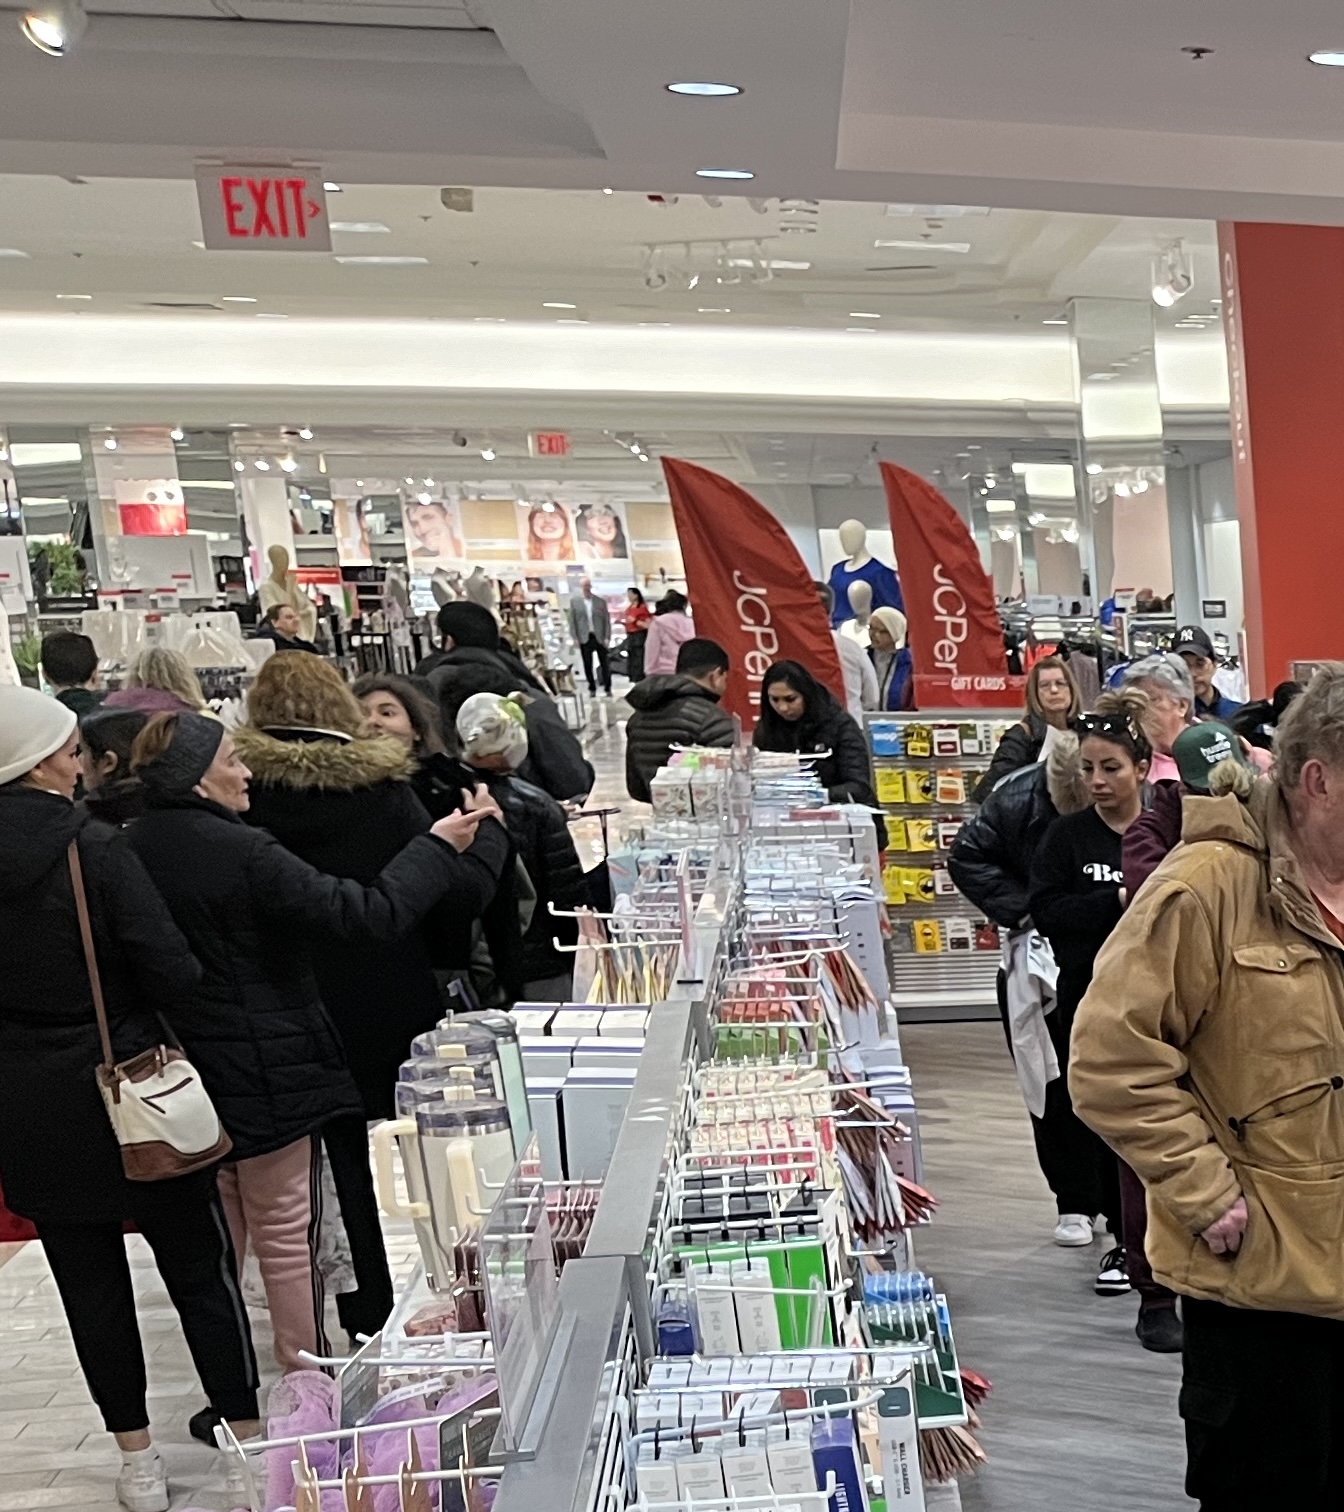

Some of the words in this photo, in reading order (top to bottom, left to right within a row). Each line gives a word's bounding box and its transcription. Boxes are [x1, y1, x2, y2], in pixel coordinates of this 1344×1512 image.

[220, 177, 306, 239] EXIT
[537, 433, 566, 456] EXIT
[951, 676, 972, 691] GIFT
[973, 676, 1008, 691] CARDS
